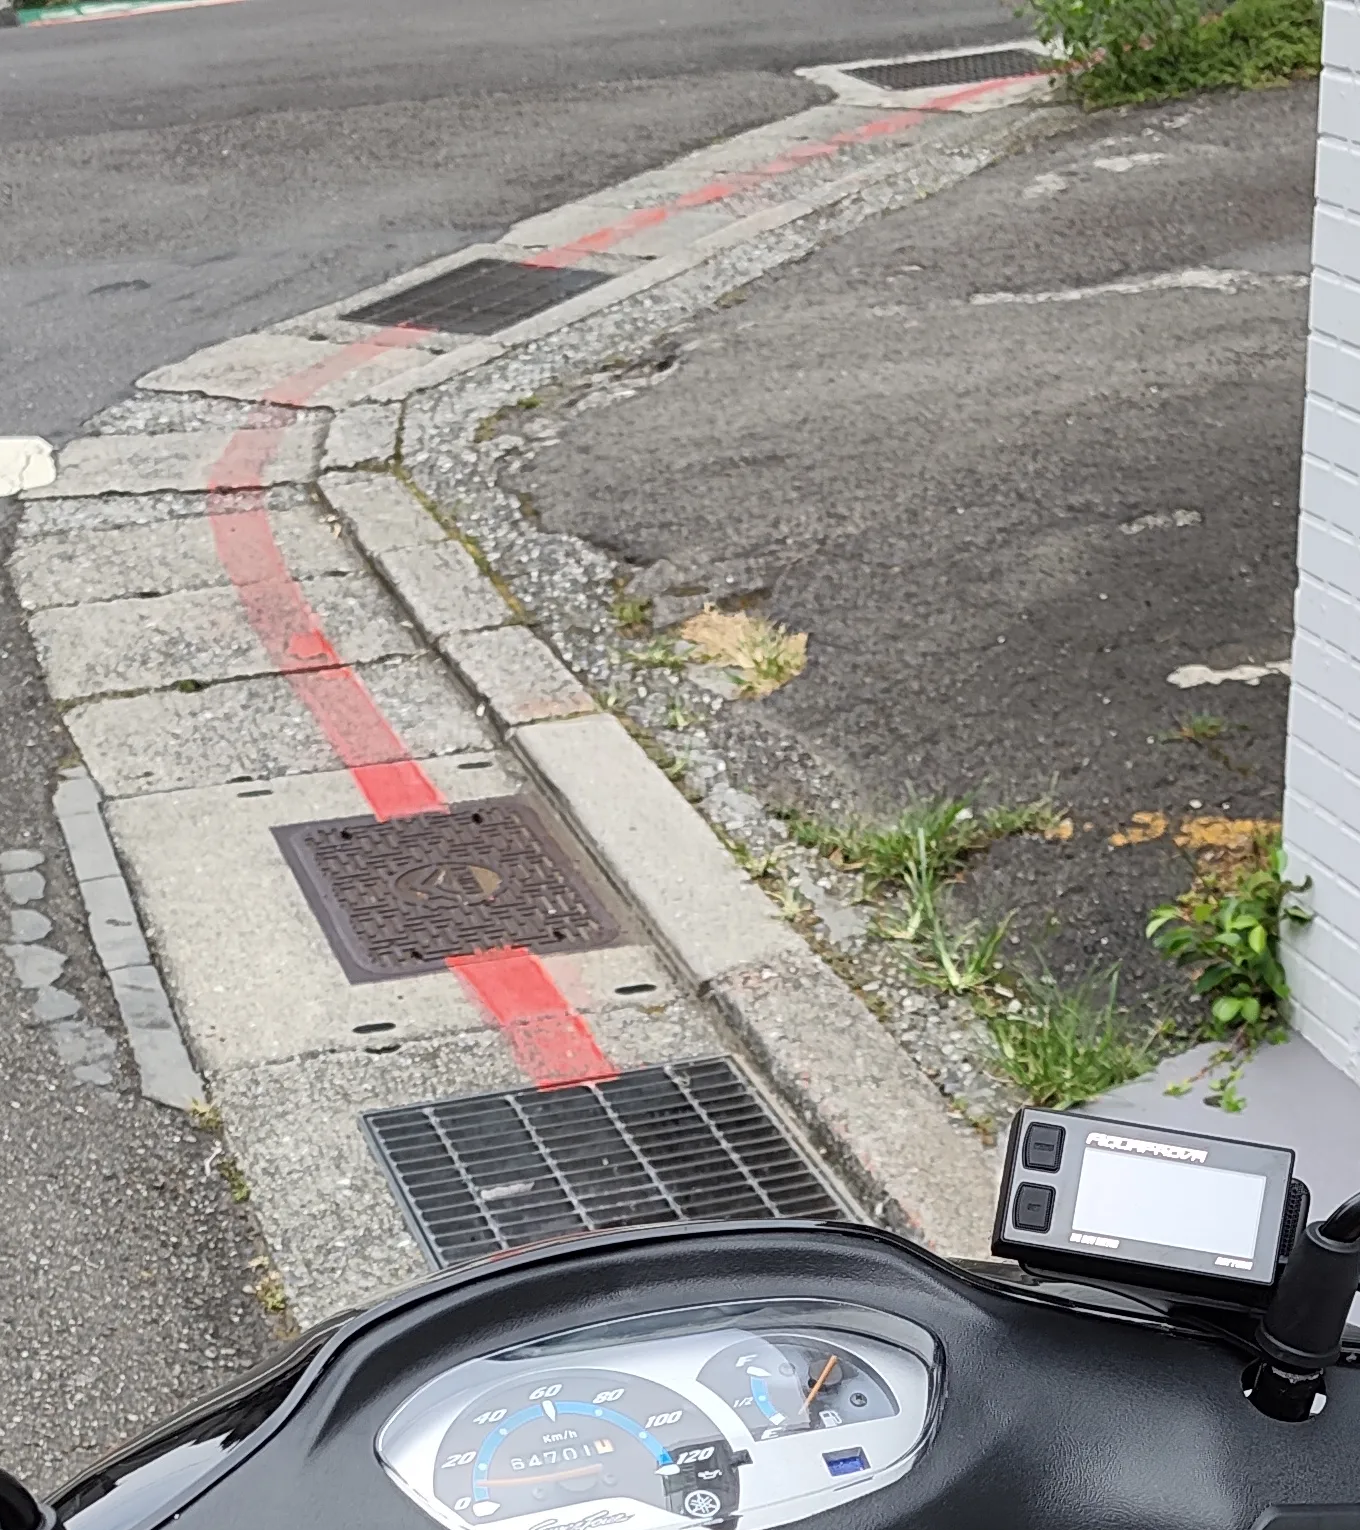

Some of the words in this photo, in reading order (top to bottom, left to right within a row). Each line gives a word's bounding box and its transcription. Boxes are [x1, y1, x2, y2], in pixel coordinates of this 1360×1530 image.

[735, 1354, 759, 1367] F
[529, 1384, 563, 1400] 60
[592, 1388, 625, 1404] 80
[473, 1408, 507, 1425] 40
[643, 1411, 682, 1428] 100
[761, 1427, 783, 1439] E
[441, 1451, 478, 1469] 20
[676, 1447, 715, 1464] 120
[454, 1497, 471, 1511] 0
